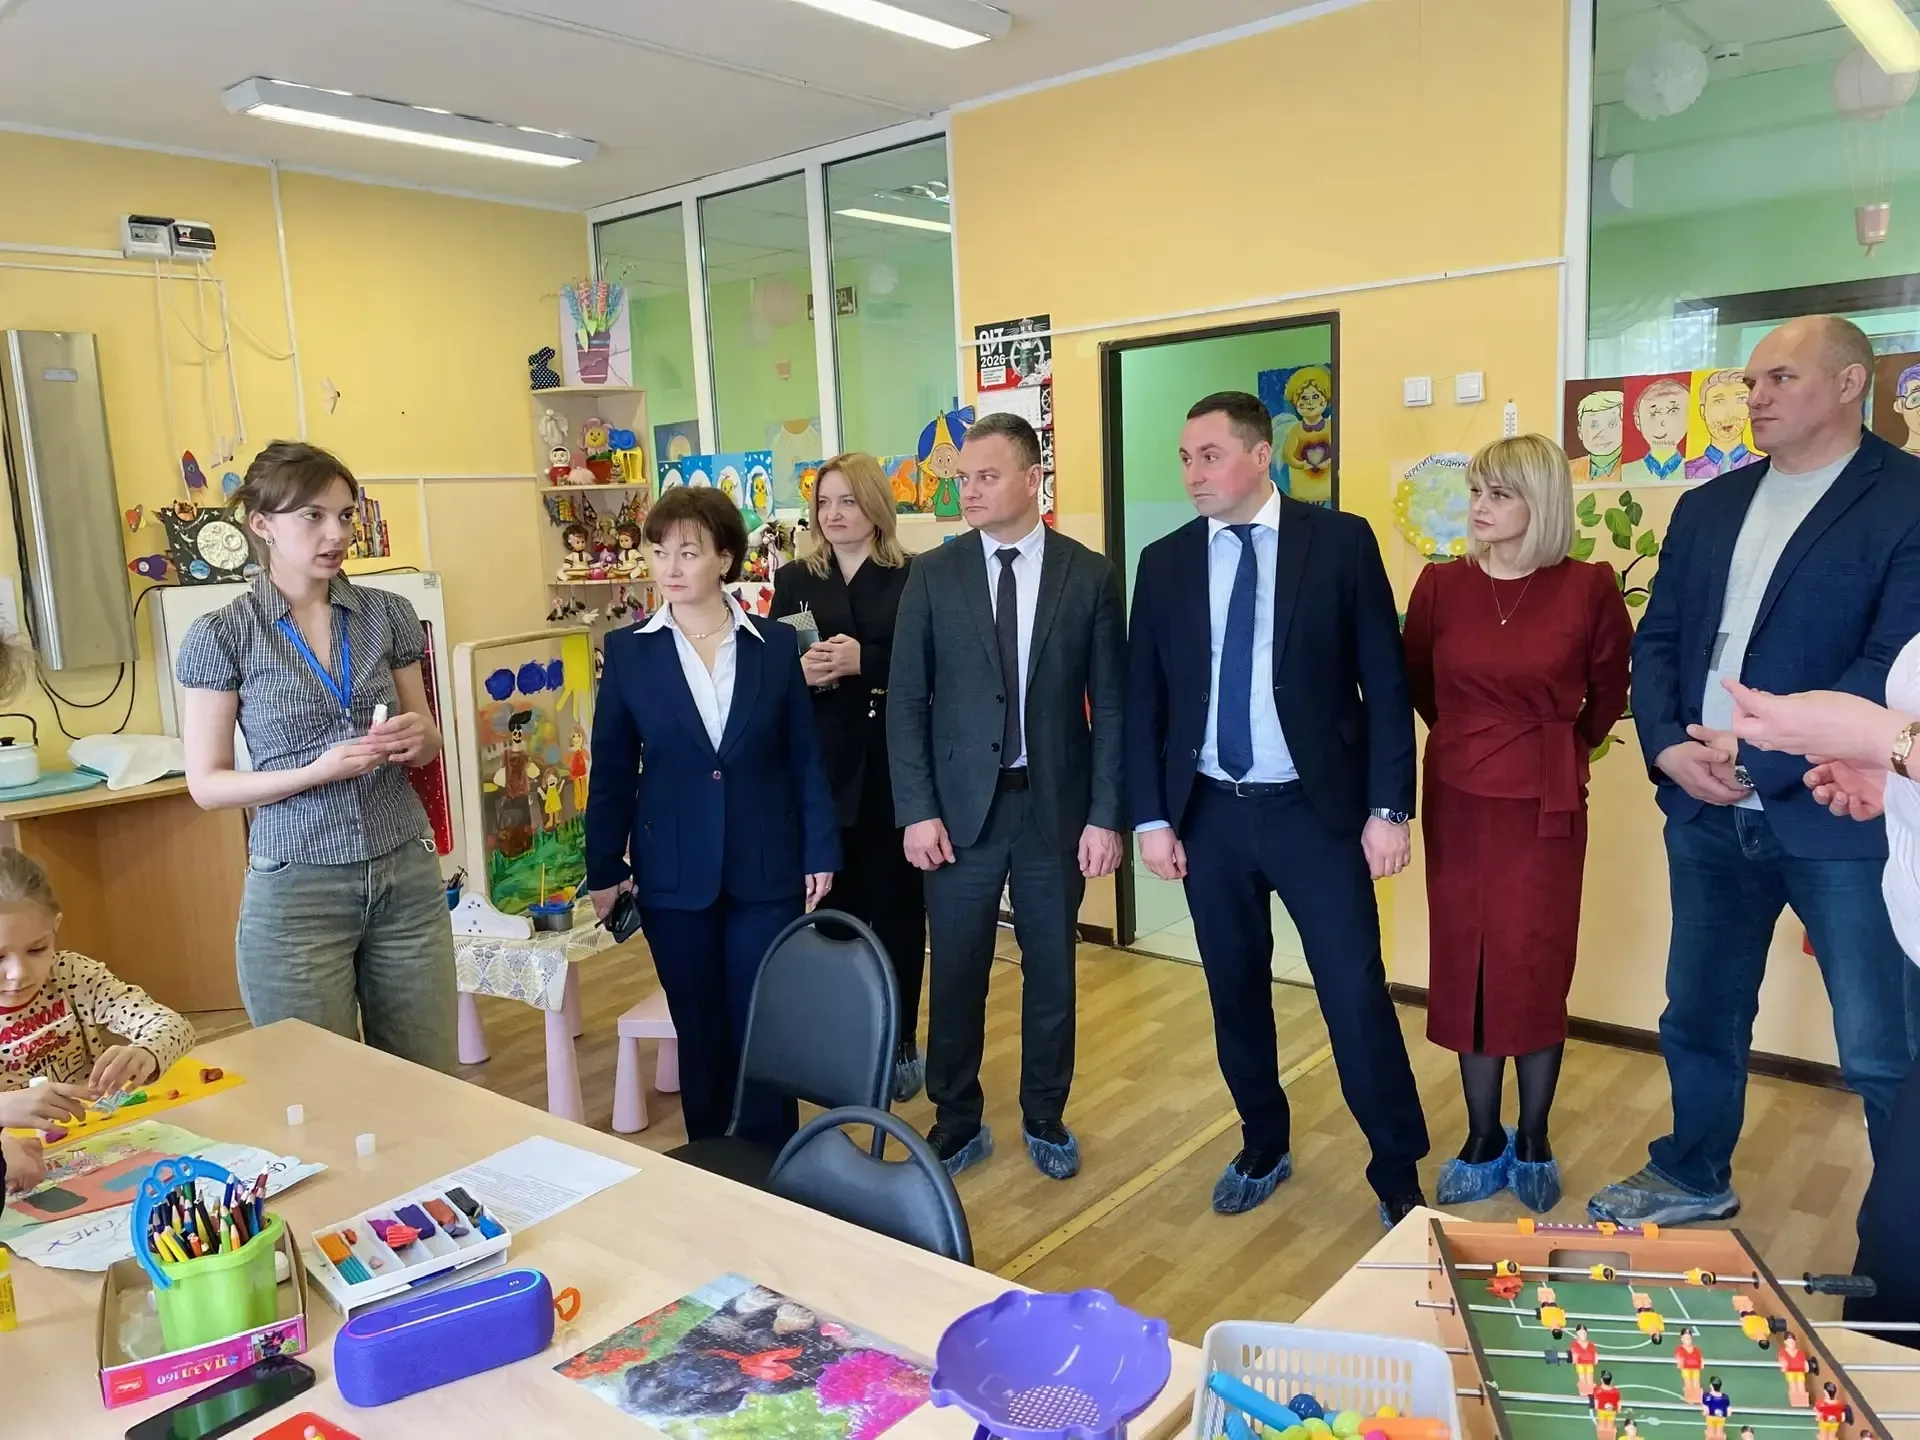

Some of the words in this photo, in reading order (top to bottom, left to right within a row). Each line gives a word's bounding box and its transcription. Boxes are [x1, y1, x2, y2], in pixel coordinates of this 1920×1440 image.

[980, 354, 1006, 367] 2026
[1404, 453, 1434, 480] БЕРЕГИТЕ
[180, 1357, 228, 1378] ПАЗЛ
[157, 1371, 180, 1385] 160
